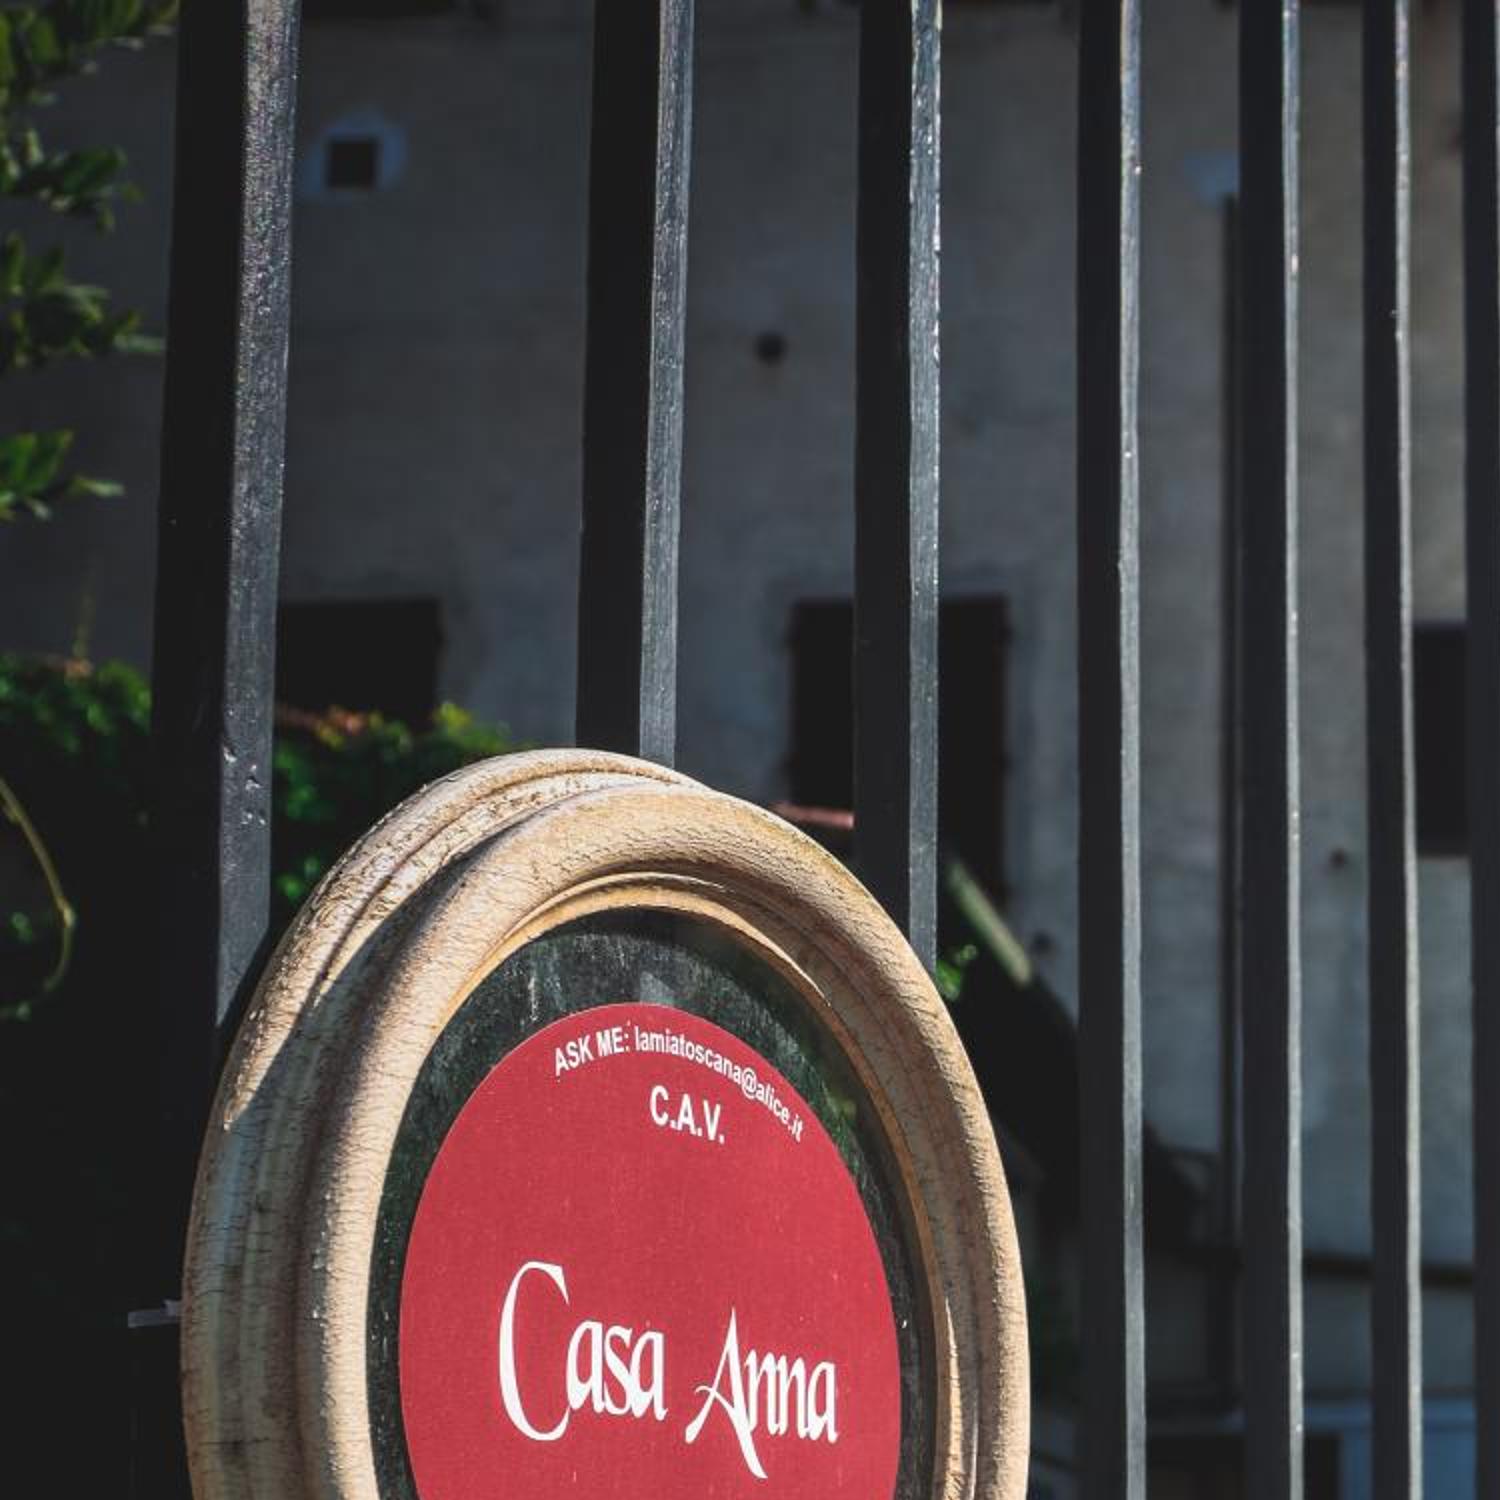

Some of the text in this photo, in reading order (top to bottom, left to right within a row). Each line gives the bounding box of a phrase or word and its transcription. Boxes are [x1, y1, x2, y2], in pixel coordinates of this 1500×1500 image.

[556, 1025, 804, 1144] ASK ME: lamiatoscana@alice.it
[650, 1084, 725, 1144] C.A.V.
[499, 1261, 839, 1479] Casa Anna
